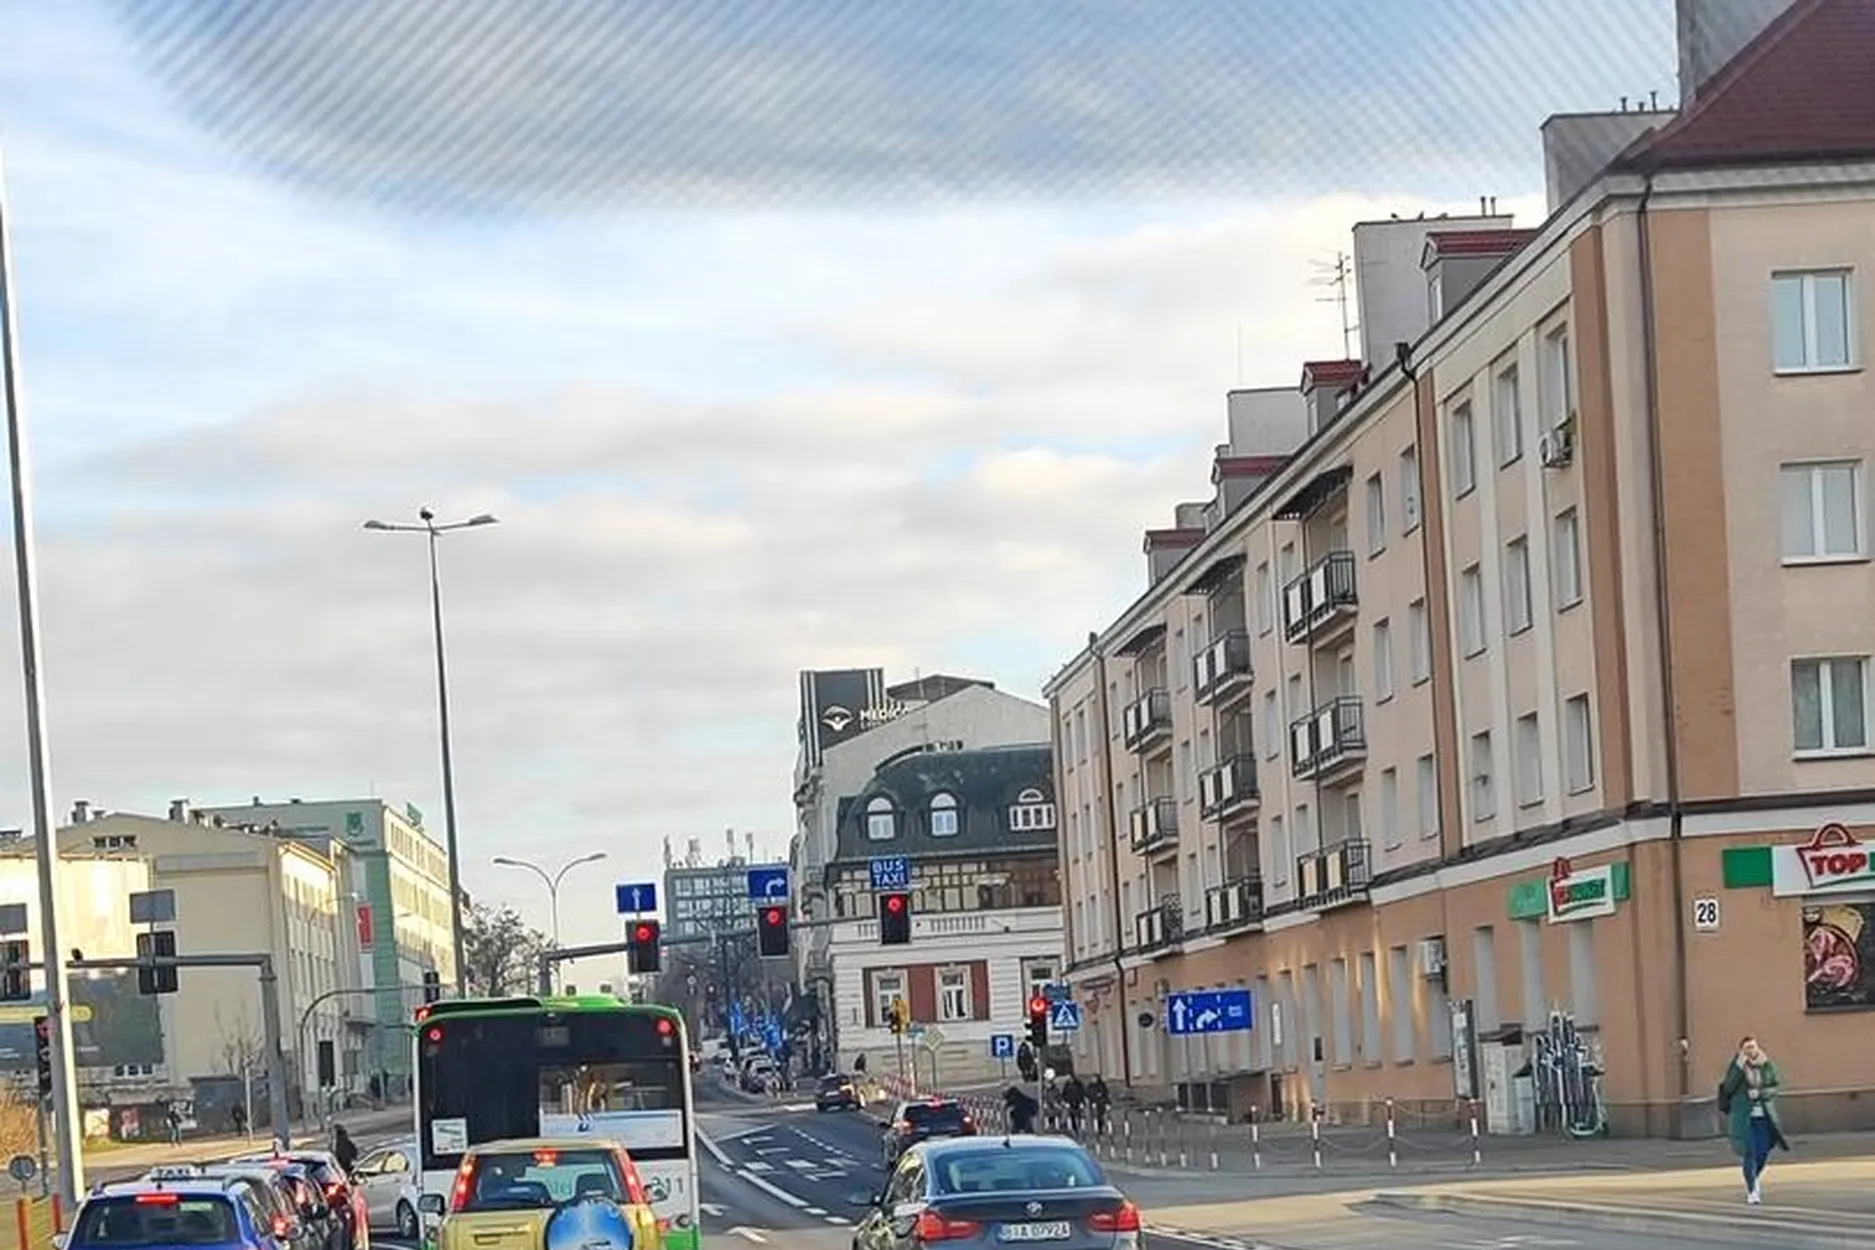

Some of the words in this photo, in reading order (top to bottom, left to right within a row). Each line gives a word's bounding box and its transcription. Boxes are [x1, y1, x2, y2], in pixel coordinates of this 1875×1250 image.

[872, 860, 904, 873] BUS
[1810, 853, 1866, 877] TOP
[873, 872, 905, 885] TAXI
[1696, 902, 1717, 923] 28
[996, 1037, 1009, 1055] P
